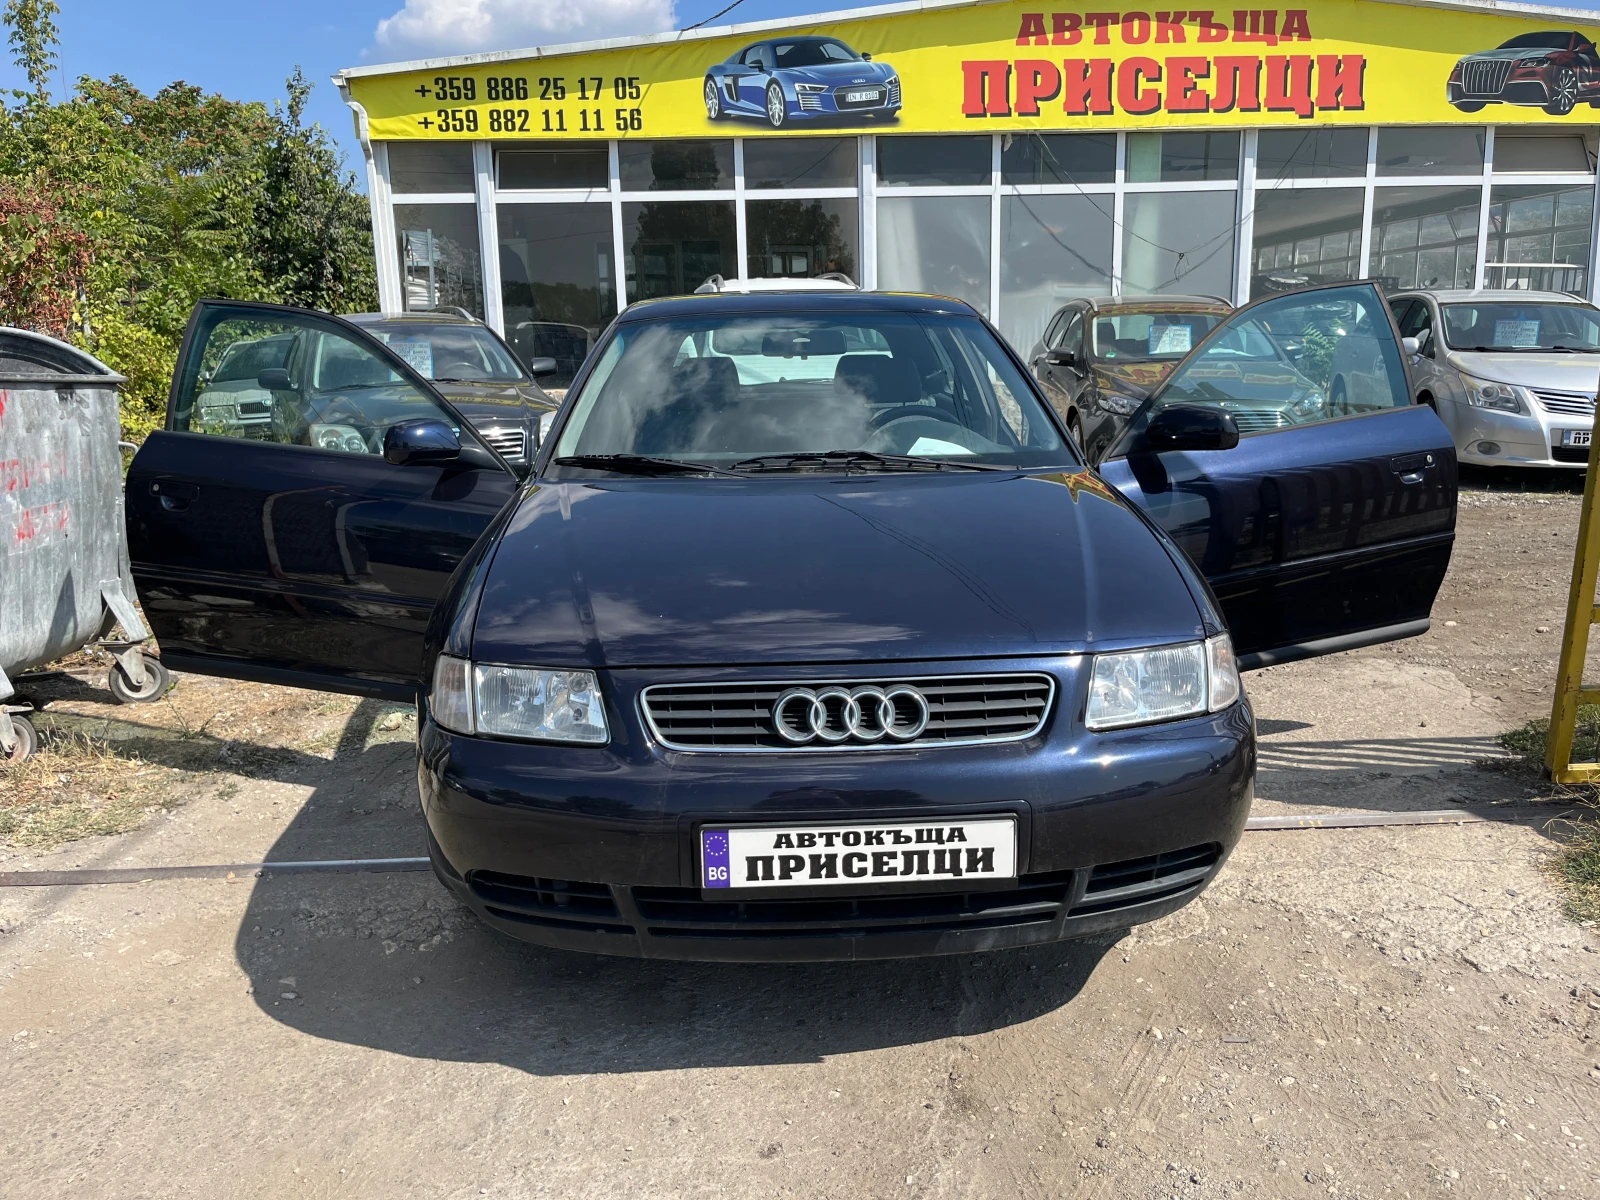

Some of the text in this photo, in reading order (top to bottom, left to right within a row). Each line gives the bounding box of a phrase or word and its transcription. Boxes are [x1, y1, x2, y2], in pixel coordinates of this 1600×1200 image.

[1016, 10, 1312, 47] АВТОКЪЩА
[414, 76, 641, 101] +359 886 25 17 05
[961, 54, 1367, 119] ПРИСЕЛЦИ
[417, 108, 643, 132] +359 882 11 11 56
[773, 826, 968, 849] АВТОКЪЩА
[708, 866, 728, 881] BG
[745, 847, 995, 882] ПРИСЕЛЦИ
